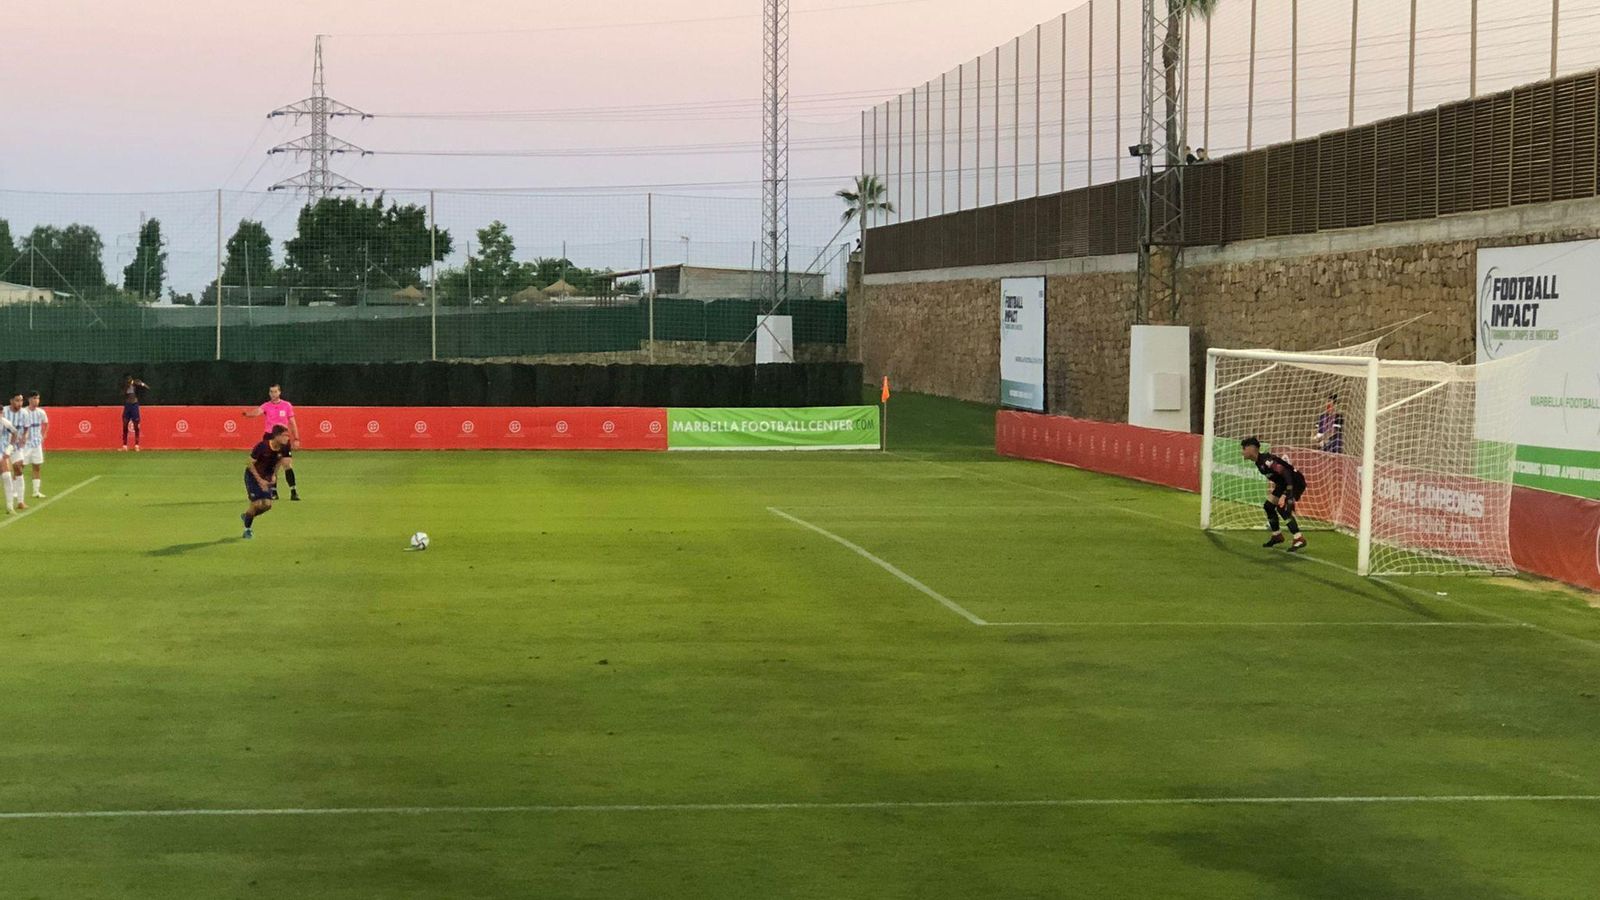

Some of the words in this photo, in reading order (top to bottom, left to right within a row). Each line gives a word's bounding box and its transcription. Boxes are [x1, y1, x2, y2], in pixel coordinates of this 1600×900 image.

[1493, 275, 1559, 301] FOOTBALL
[1491, 303, 1539, 328] IMPACT
[1530, 395, 1563, 408] MARBELLA
[1566, 396, 1600, 410] FOOTBALL
[672, 420, 739, 433] MARBELLA
[741, 420, 807, 433] FOOTBALL
[1418, 483, 1485, 518] CAMPEONES
